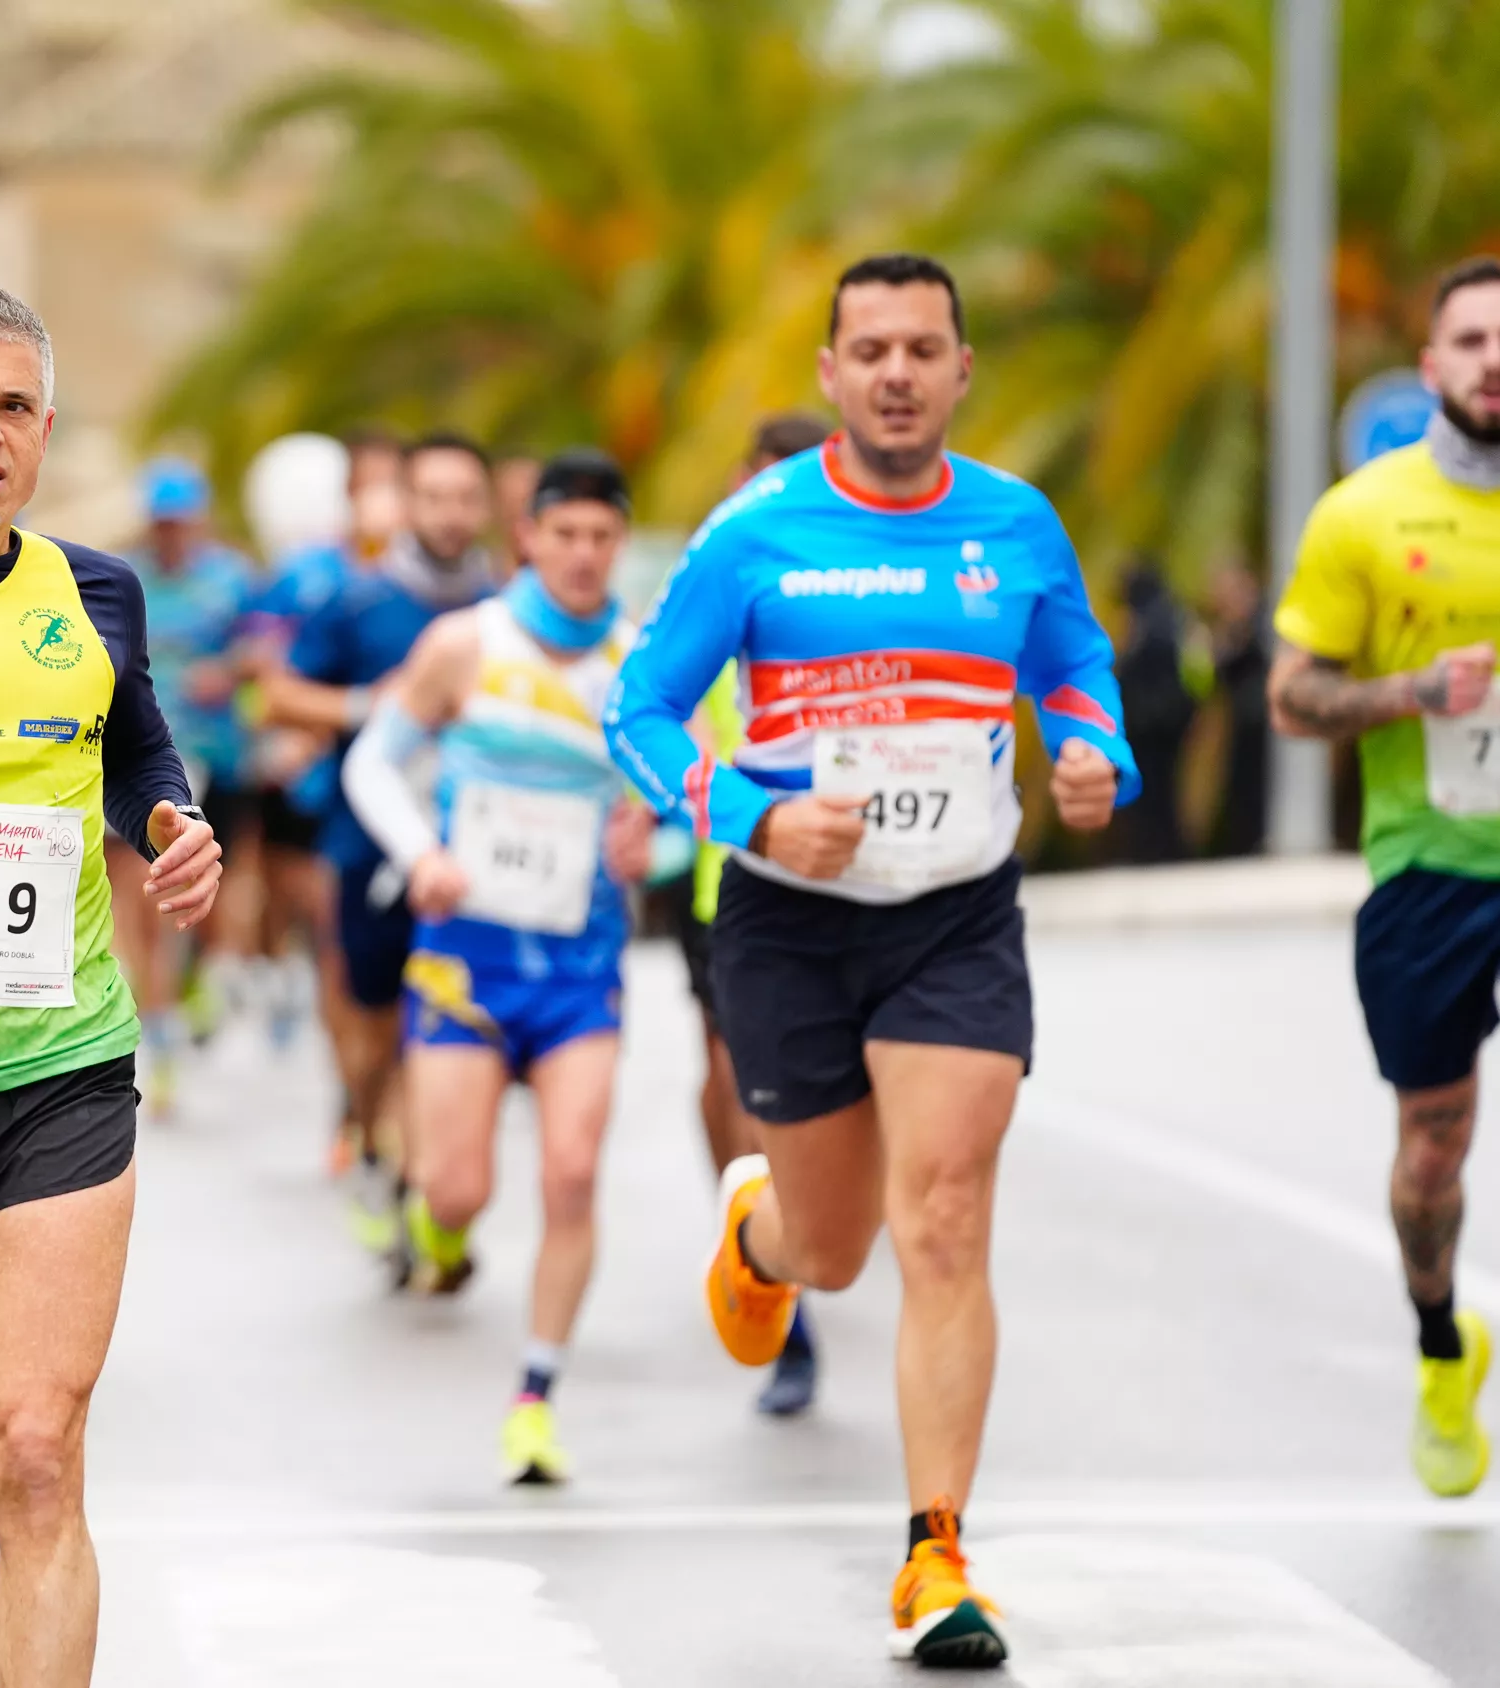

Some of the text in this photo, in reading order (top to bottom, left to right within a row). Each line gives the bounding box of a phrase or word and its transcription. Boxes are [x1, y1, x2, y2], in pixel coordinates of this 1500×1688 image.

[779, 563, 927, 598] enerplus
[18, 608, 75, 629] CLUB ATLETISMO
[21, 640, 83, 670] RUNNERS PURA CEPA
[1467, 728, 1500, 767] 7
[861, 788, 952, 832] 497
[11, 951, 35, 959] DOBLAS
